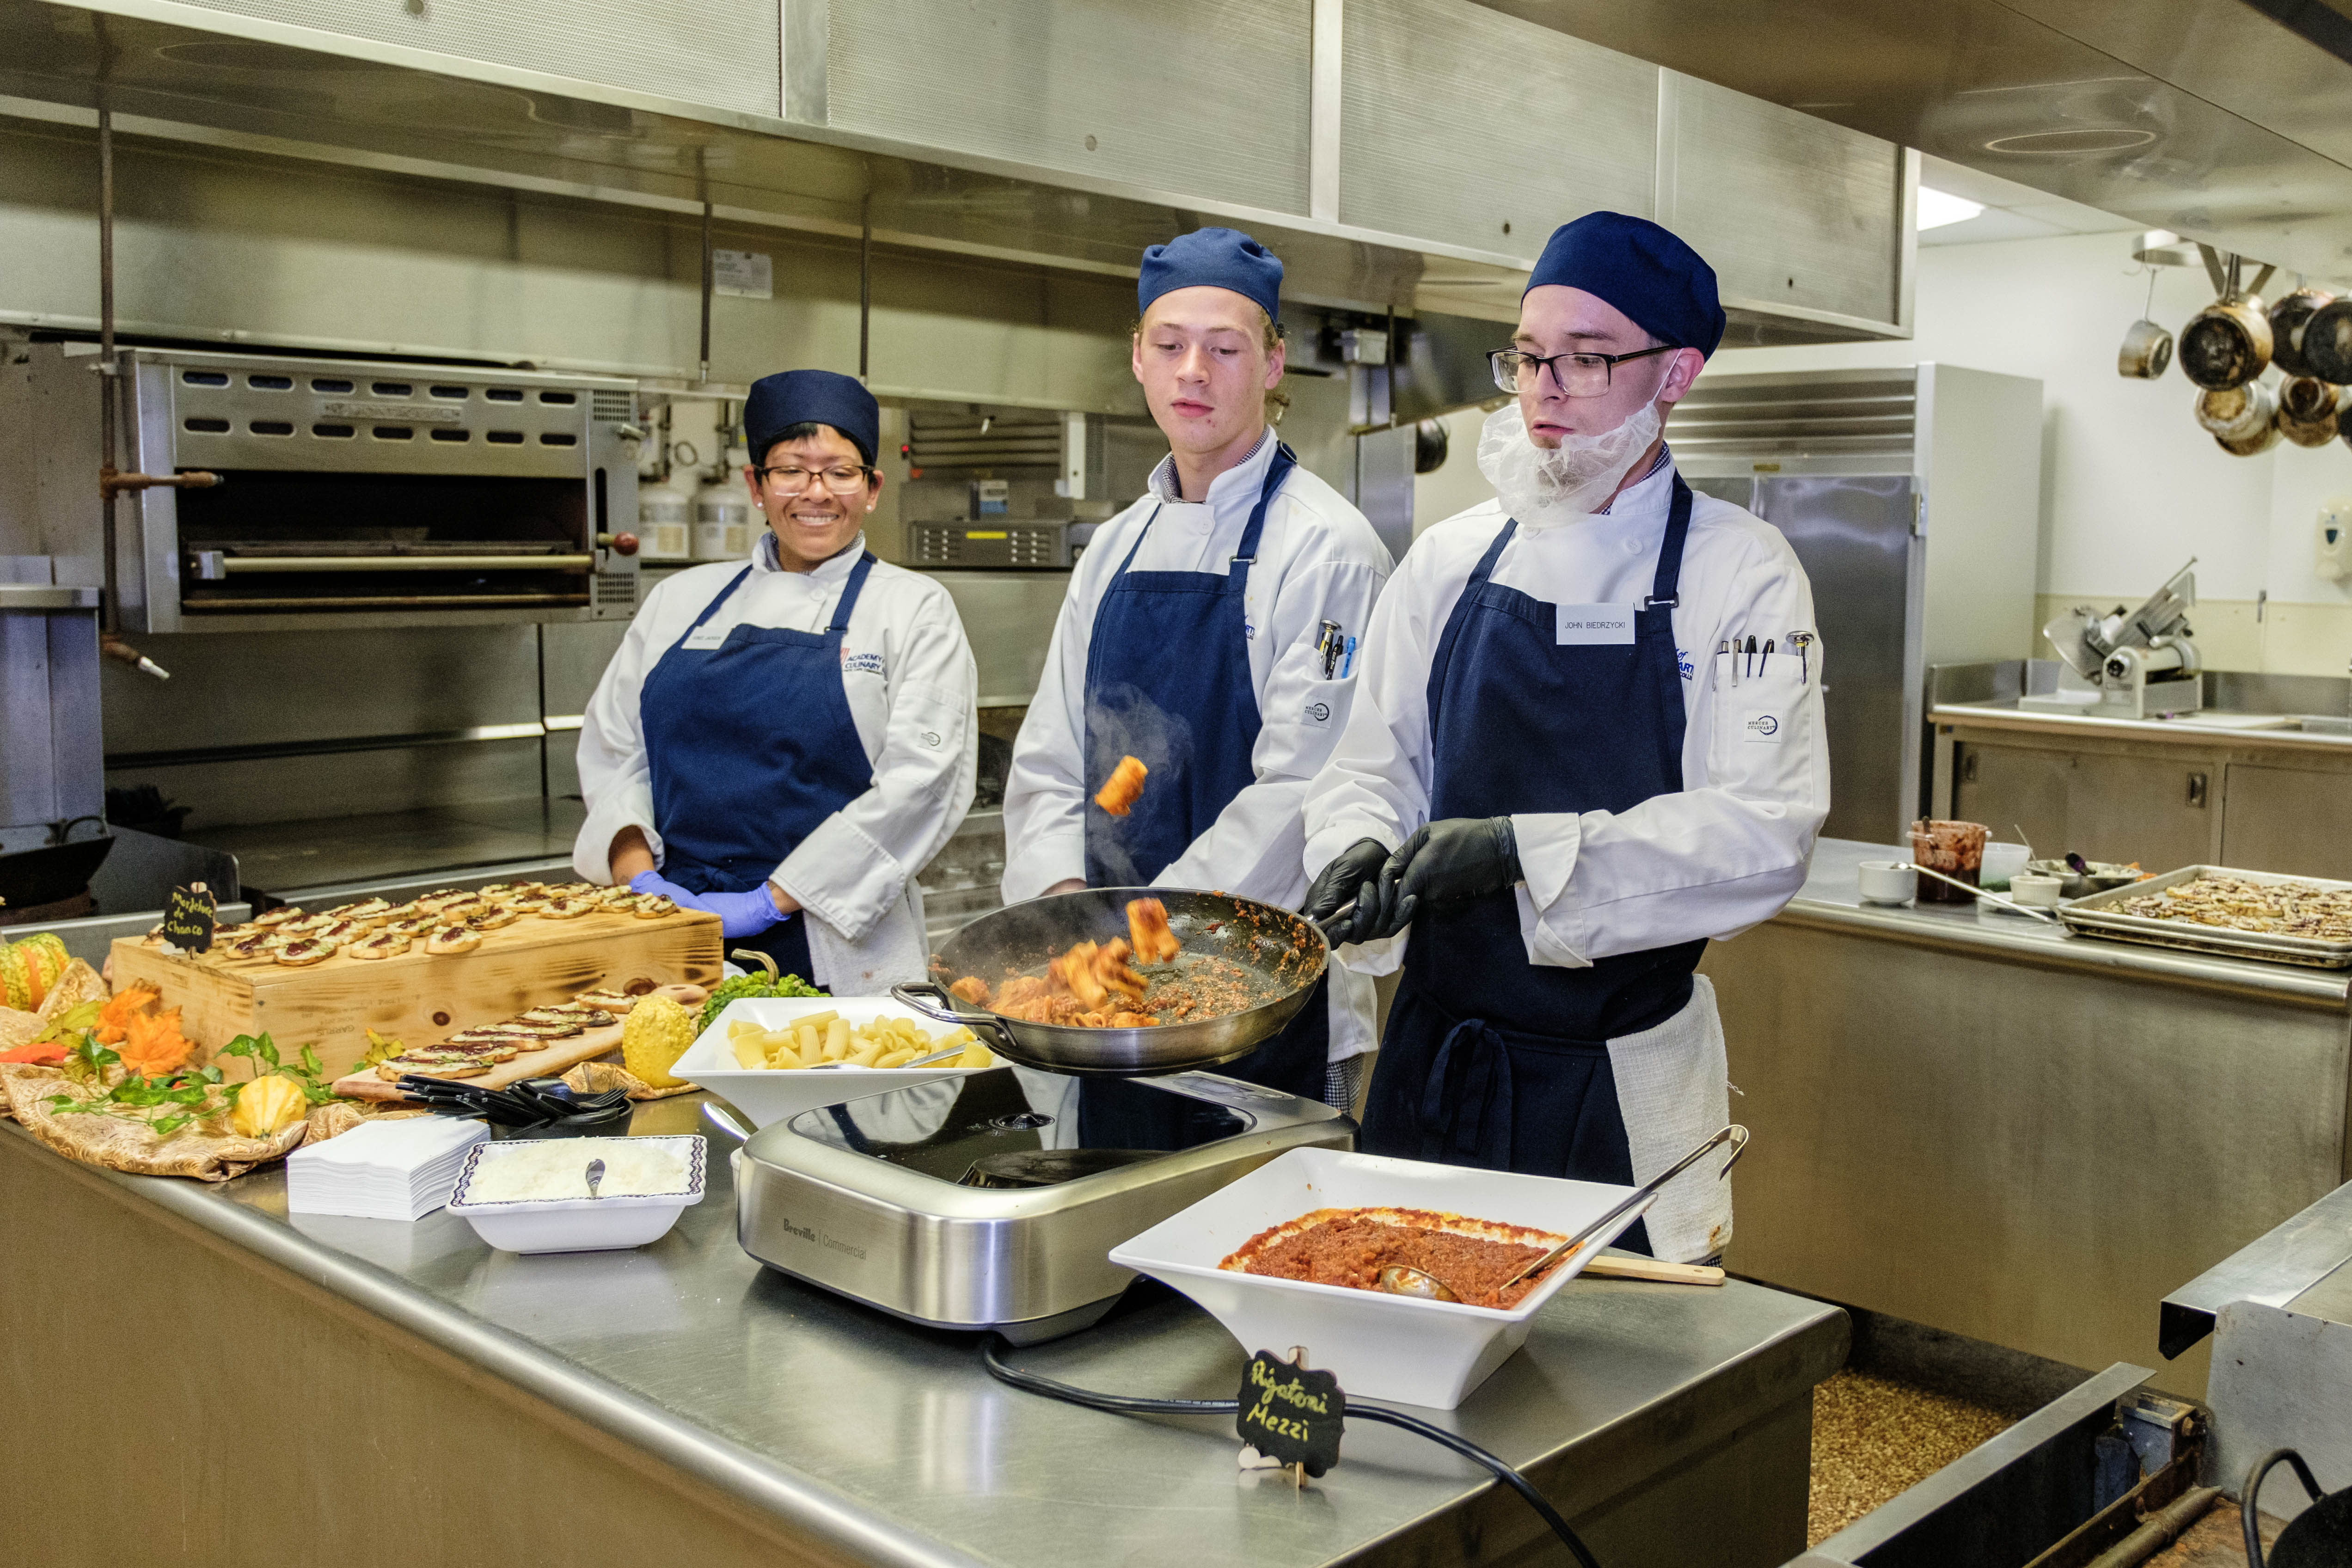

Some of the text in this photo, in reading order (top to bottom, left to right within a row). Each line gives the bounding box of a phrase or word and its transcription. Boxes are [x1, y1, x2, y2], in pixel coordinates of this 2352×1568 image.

[847, 653, 883, 662] ACADEMY
[845, 662, 881, 670] CULINARY
[173, 906, 184, 919] de
[316, 1024, 355, 1036] GARRUS
[783, 1218, 867, 1260] Breville Commercial
[1251, 1359, 1328, 1415] Rigatoni
[1246, 1402, 1309, 1442] Mezzi
